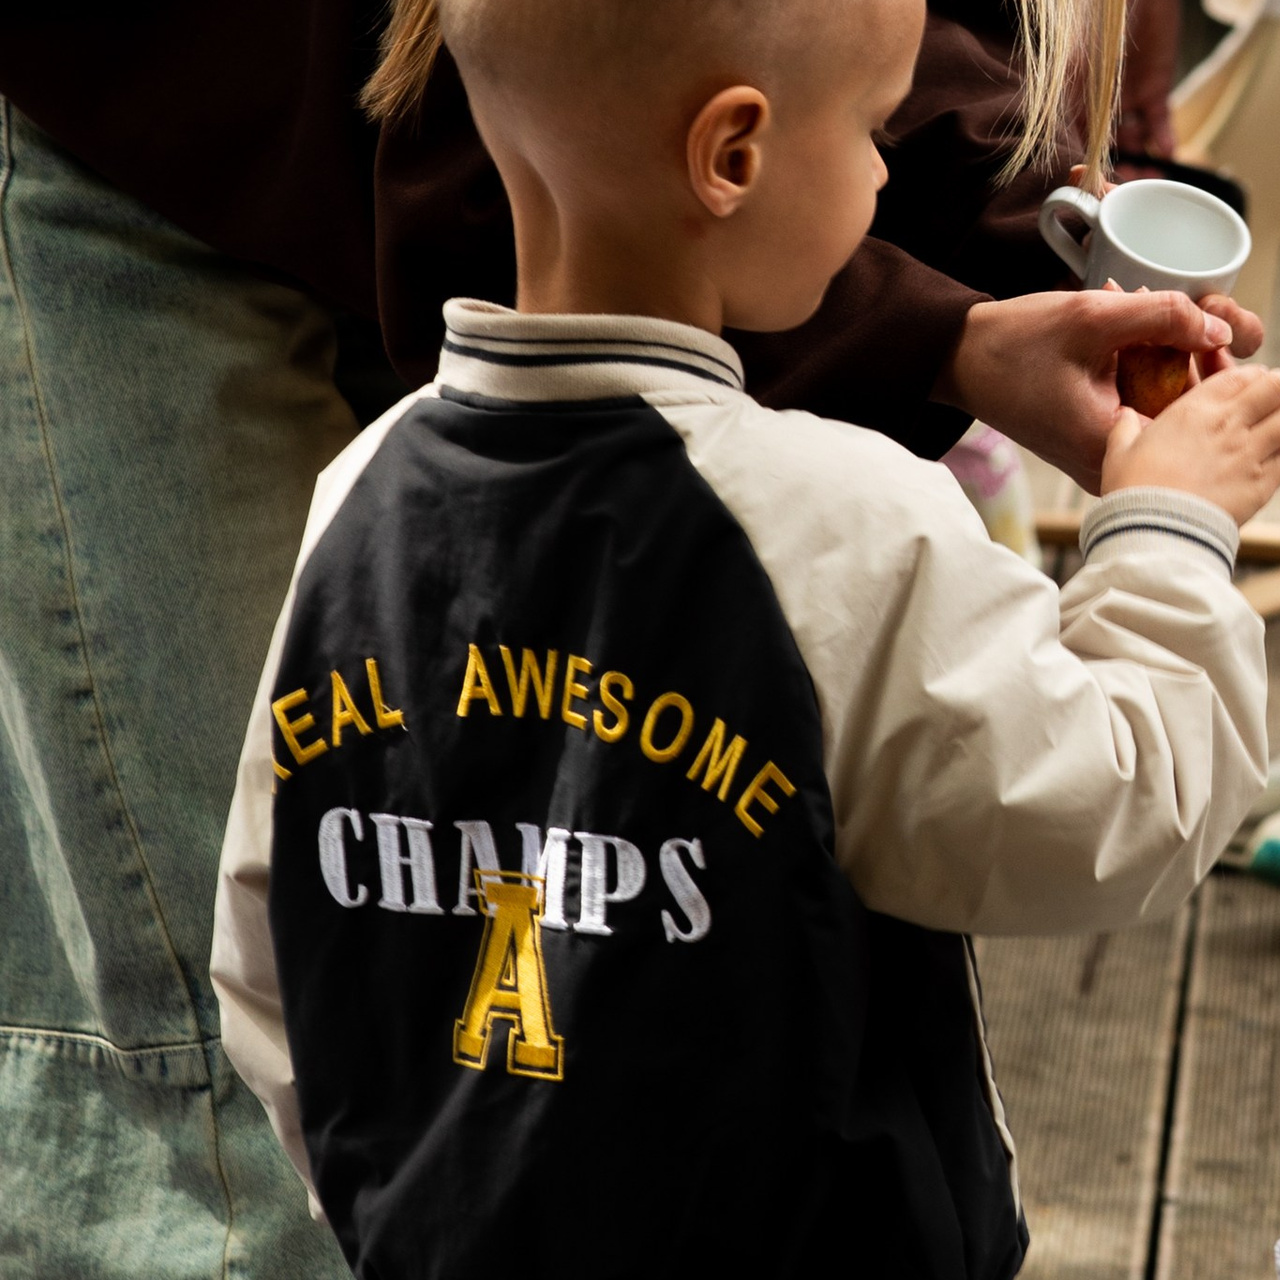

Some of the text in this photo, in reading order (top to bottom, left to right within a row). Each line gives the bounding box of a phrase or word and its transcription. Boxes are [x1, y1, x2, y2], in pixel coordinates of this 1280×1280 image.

[271, 642, 797, 839] EAL AWESOME
[317, 806, 712, 943] CHAMPS
[452, 869, 565, 1081] A
